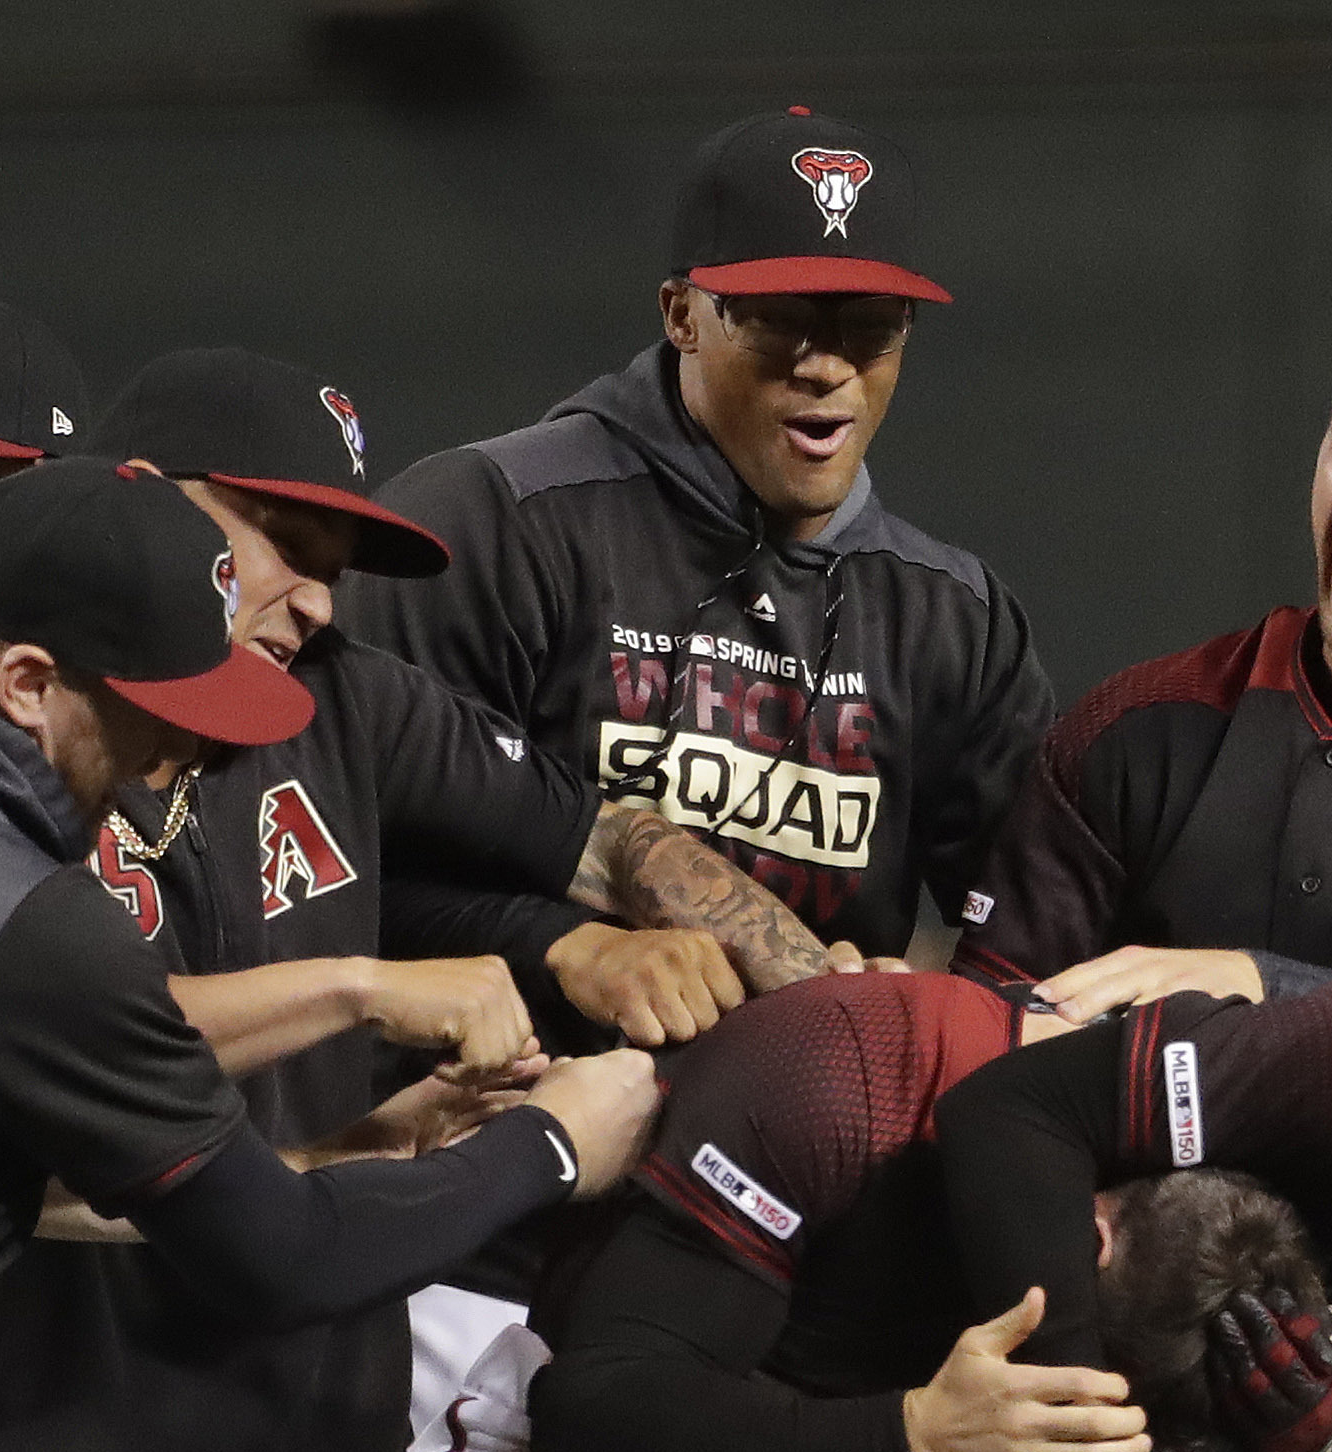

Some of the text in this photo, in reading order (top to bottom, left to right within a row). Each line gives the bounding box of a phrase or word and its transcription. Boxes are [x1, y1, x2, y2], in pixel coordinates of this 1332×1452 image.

[611, 624, 673, 653] 2019
[717, 638, 797, 679] SPRING
[609, 651, 877, 773] WHOLE
[605, 738, 871, 853] SQUAD
[1171, 1049, 1195, 1161] MLB 150
[698, 1153, 791, 1231] MLB 150
